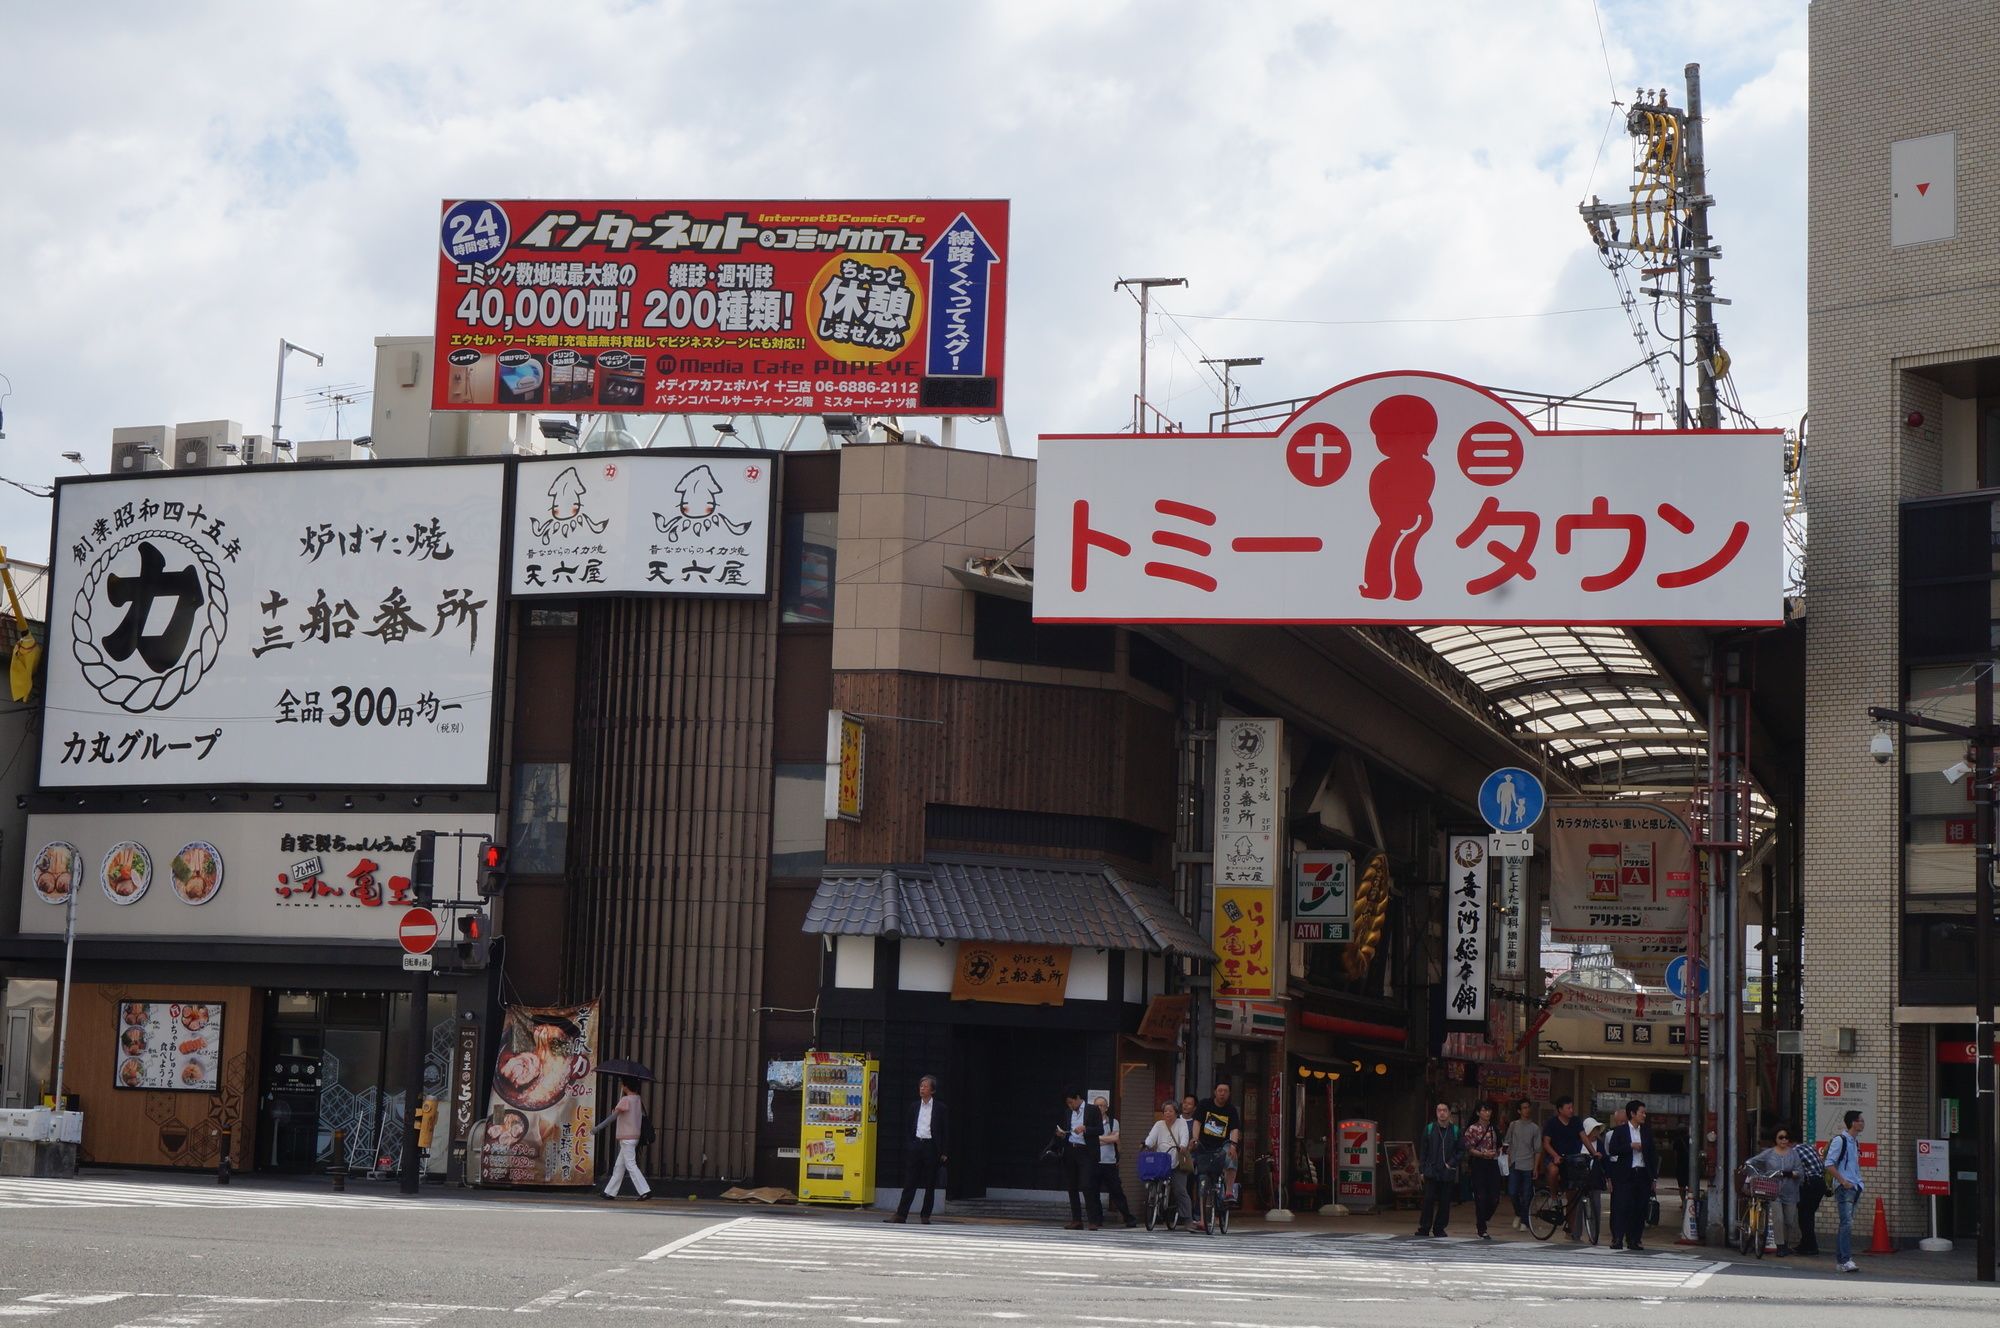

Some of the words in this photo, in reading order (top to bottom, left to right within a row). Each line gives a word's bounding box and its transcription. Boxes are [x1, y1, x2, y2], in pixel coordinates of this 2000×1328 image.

[450, 209, 499, 244] 24
[759, 213, 925, 223] Internet&ComicCafe
[453, 235, 501, 256] 時間営業
[456, 263, 637, 287] コミック数地域最大級の
[669, 264, 774, 288] 雑誌・週刊誌
[842, 260, 902, 284] ちょっと
[457, 288, 631, 331] 40,000冊!
[644, 290, 793, 332] 200種類!
[822, 278, 912, 330] 休憩
[945, 230, 975, 371] 線路くぐってスグ!
[819, 319, 902, 348] しませんか
[680, 360, 743, 374] Media
[753, 361, 804, 375] Cafe
[814, 361, 920, 376] POPEYE
[656, 379, 769, 392] メディアカフェポパイ
[774, 379, 811, 393] 十三店
[815, 381, 918, 393] 06-6886-2112
[823, 395, 917, 408] ミスタードーナツ横
[72, 498, 242, 565] 創業昭和四十五年
[300, 517, 454, 564] 炉ばた焼
[526, 544, 607, 558] 昔ながらのイカ焼
[649, 545, 749, 557] 昔ながらのイカ焼
[1070, 498, 1323, 593] トミー
[1455, 496, 1750, 596] タウン
[524, 558, 608, 587] 天六屋
[646, 560, 751, 586] 天六屋
[102, 541, 204, 673] 力
[252, 586, 488, 659] 十三船番所
[274, 685, 463, 728] 全品300円均一
[436, 722, 464, 734] (税別)
[61, 728, 222, 764] 力丸グループ
[1235, 762, 1259, 829] 十三船番所
[295, 860, 317, 877] 九州
[1224, 872, 1264, 882] 天六屋
[275, 873, 343, 899] らーめん
[1225, 902, 1242, 920] 九州
[1506, 872, 1519, 928] とよた歯科
[1247, 902, 1268, 976] らーめん
[1297, 924, 1319, 938] ATM
[1328, 924, 1342, 938] 酒
[996, 967, 1064, 987] 十三船番所
[575, 1105, 591, 1173] にんにく
